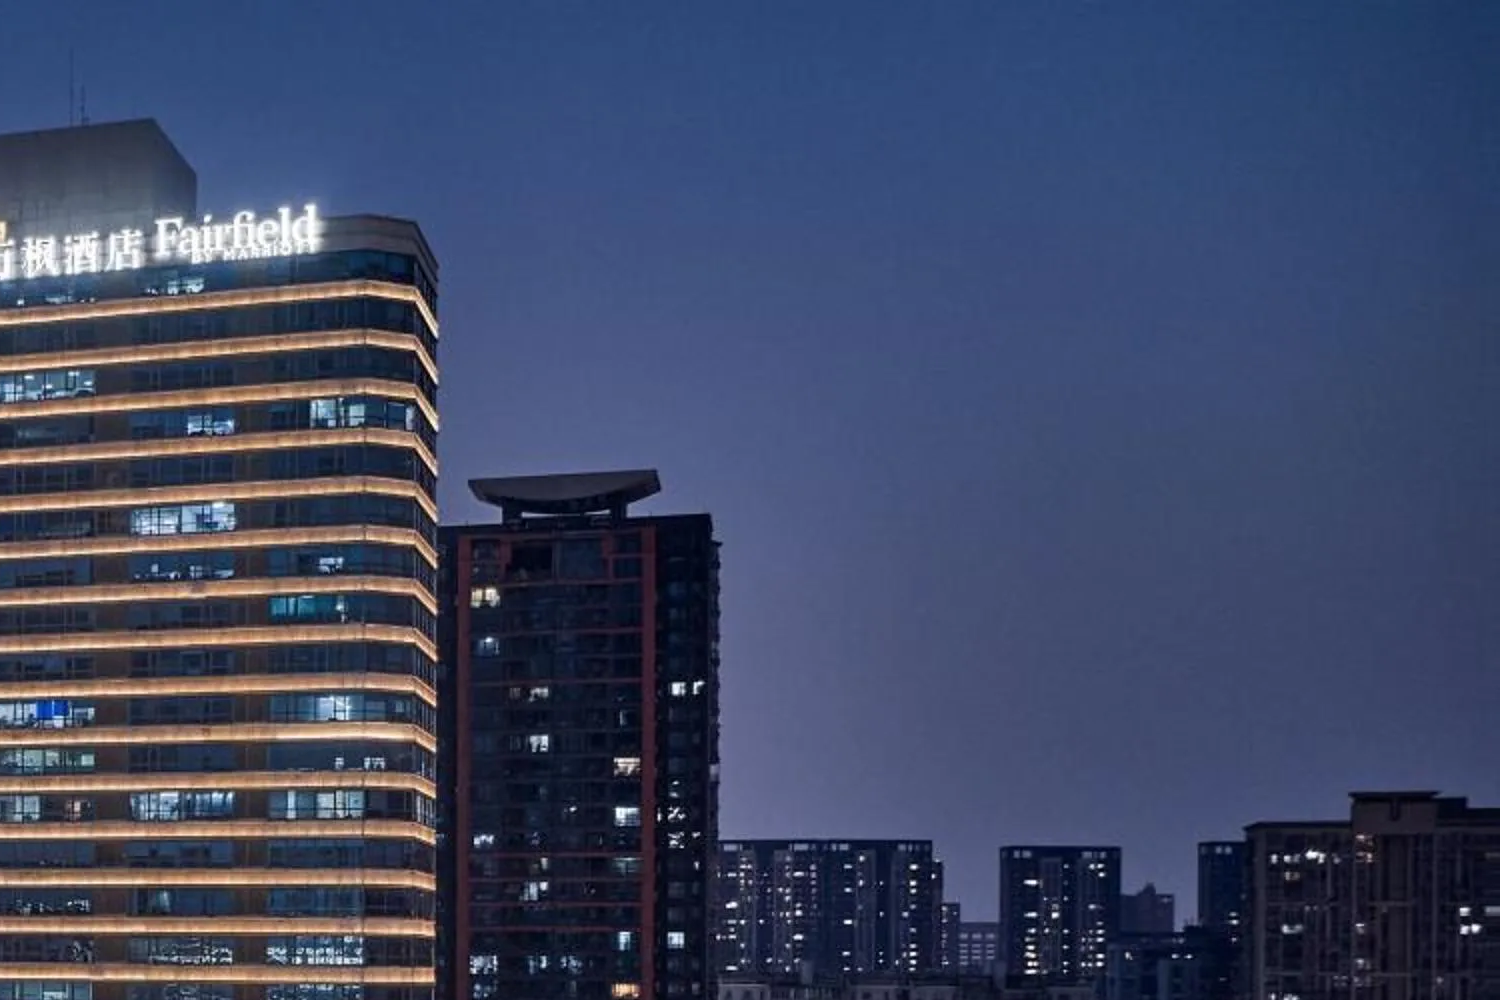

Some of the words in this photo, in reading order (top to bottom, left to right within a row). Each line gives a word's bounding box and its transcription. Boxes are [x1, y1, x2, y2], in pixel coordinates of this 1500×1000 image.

[155, 204, 319, 257] Fairfield
[191, 249, 213, 264] BY
[222, 240, 316, 261] MARRIOTT
